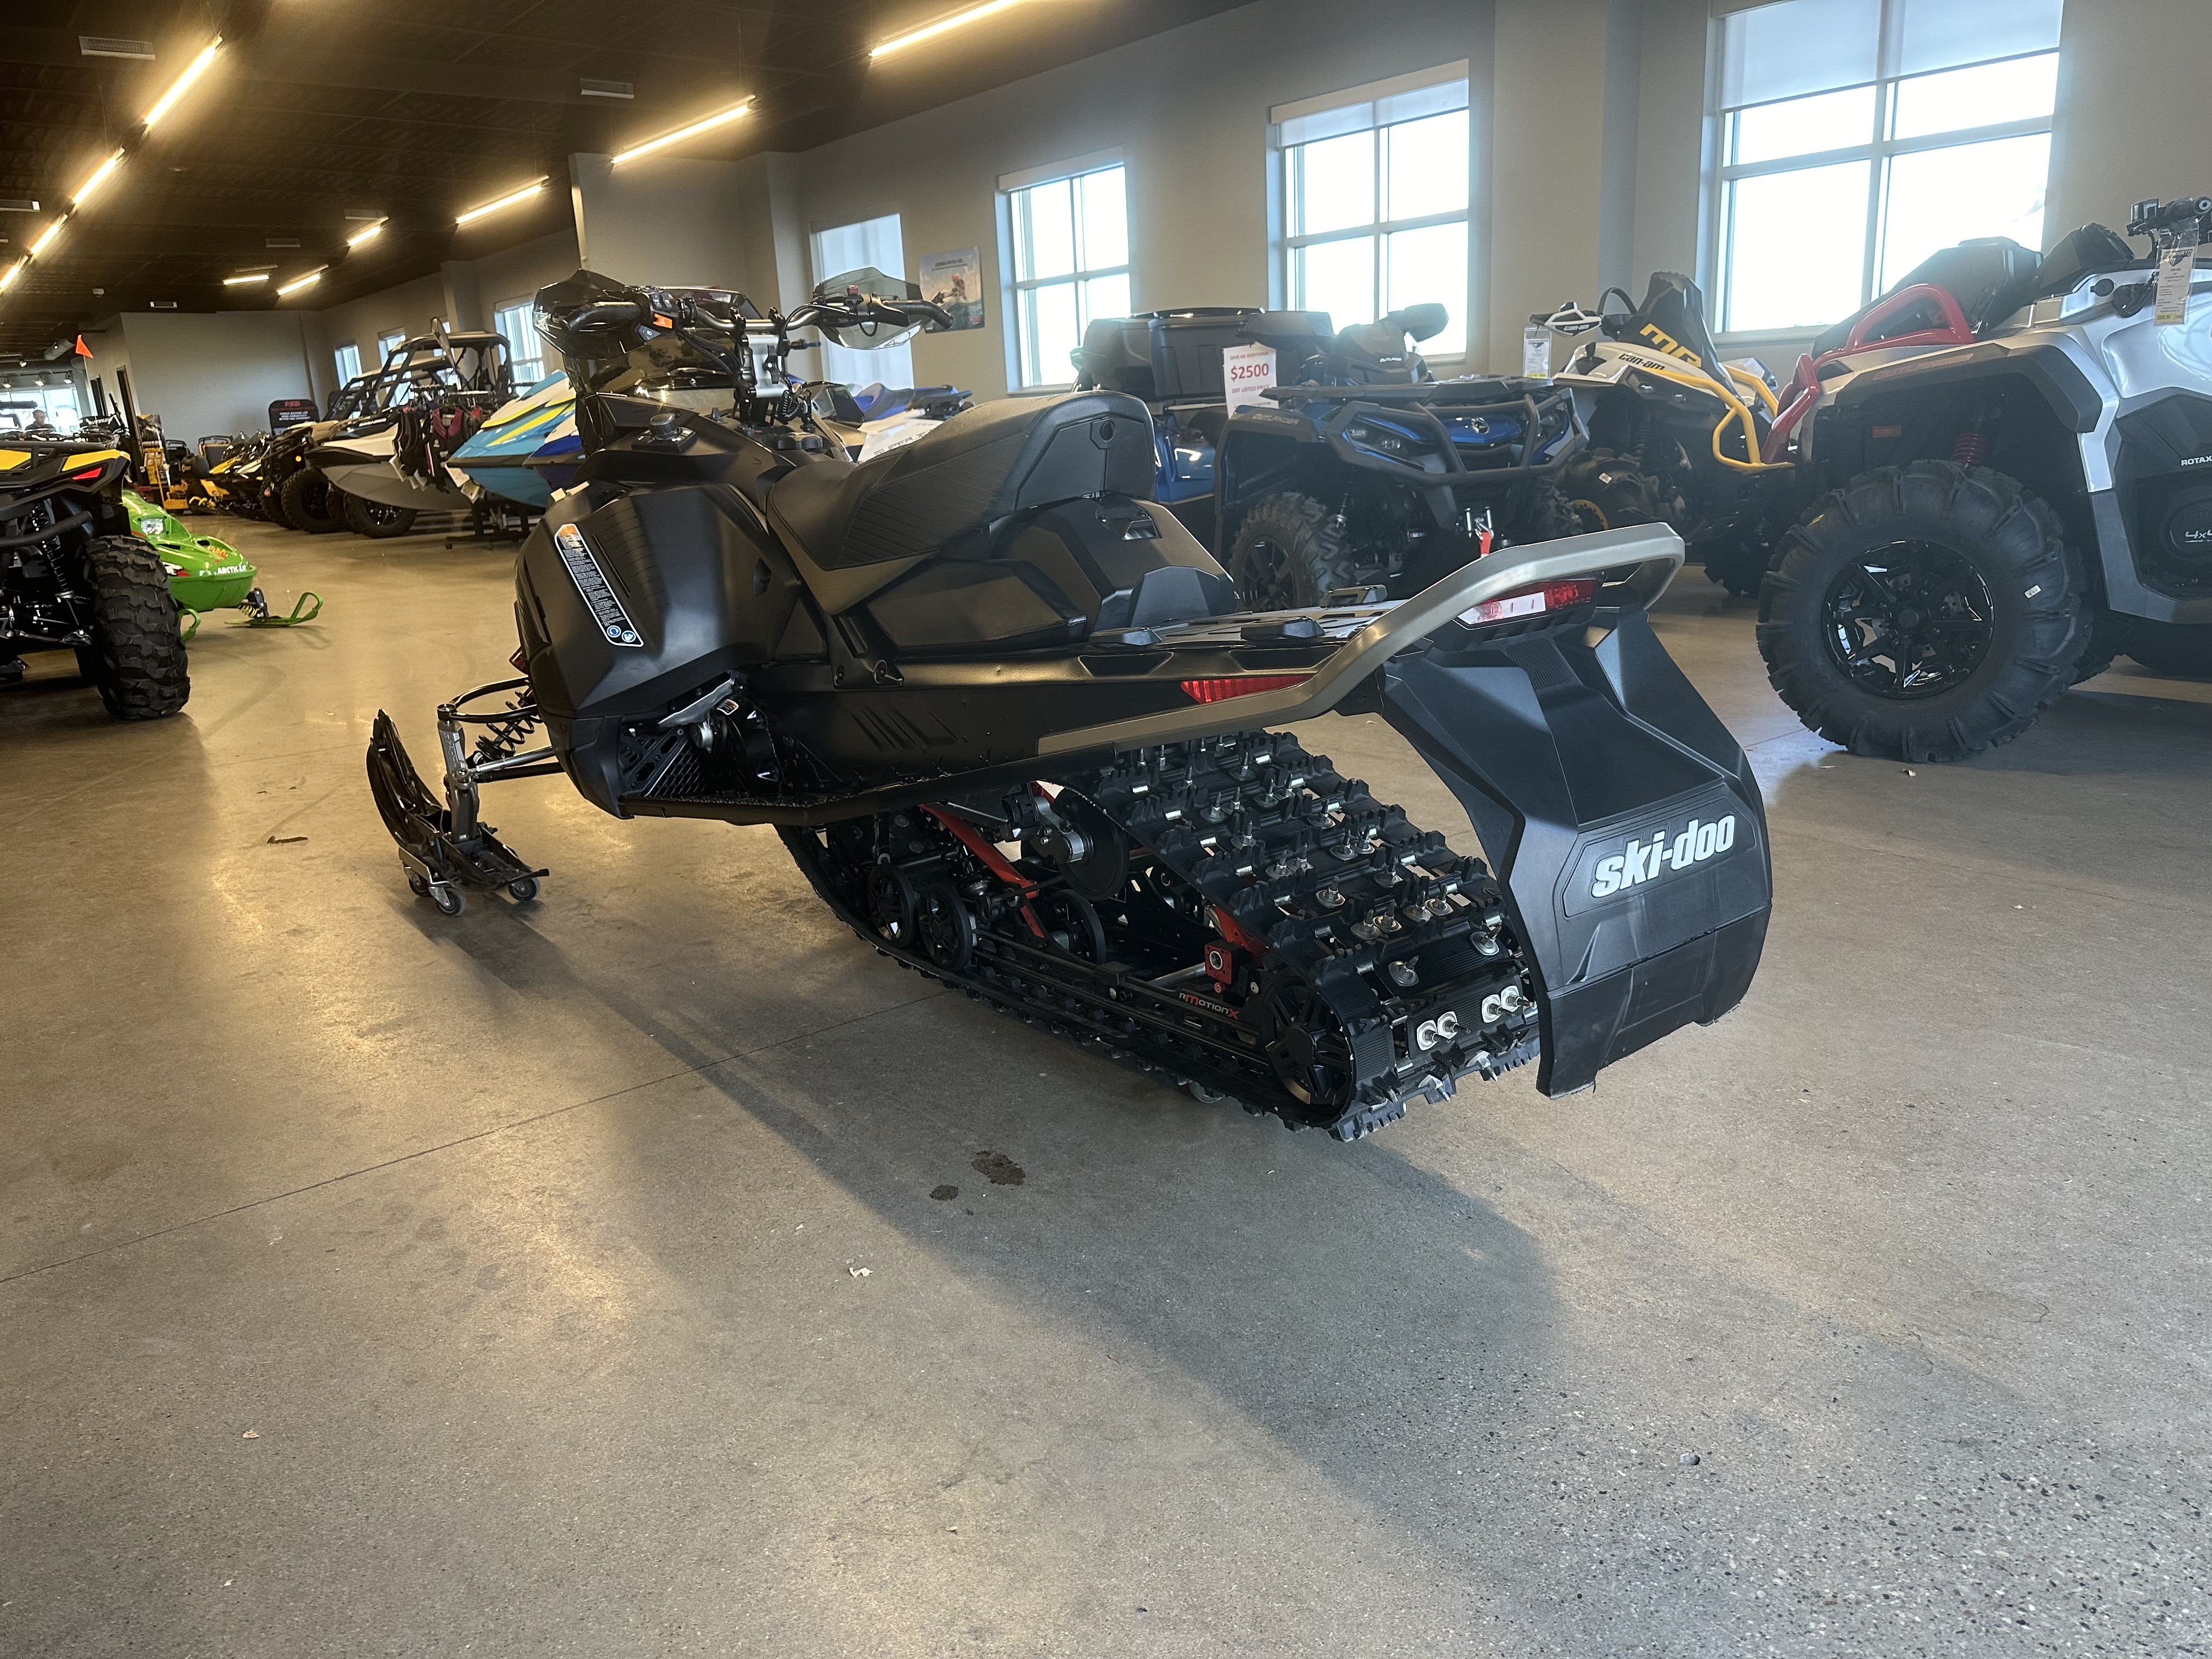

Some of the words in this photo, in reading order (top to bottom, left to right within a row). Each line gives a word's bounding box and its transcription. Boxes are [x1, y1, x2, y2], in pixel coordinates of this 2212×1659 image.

[1618, 353, 1665, 370] can-am
[1231, 363, 1269, 382] $2500
[1252, 414, 1300, 425] OUTLANDER
[2181, 455, 2212, 466] ROTAX
[217, 566, 239, 575] ARCTIC
[1591, 815, 1735, 898] ski-doo
